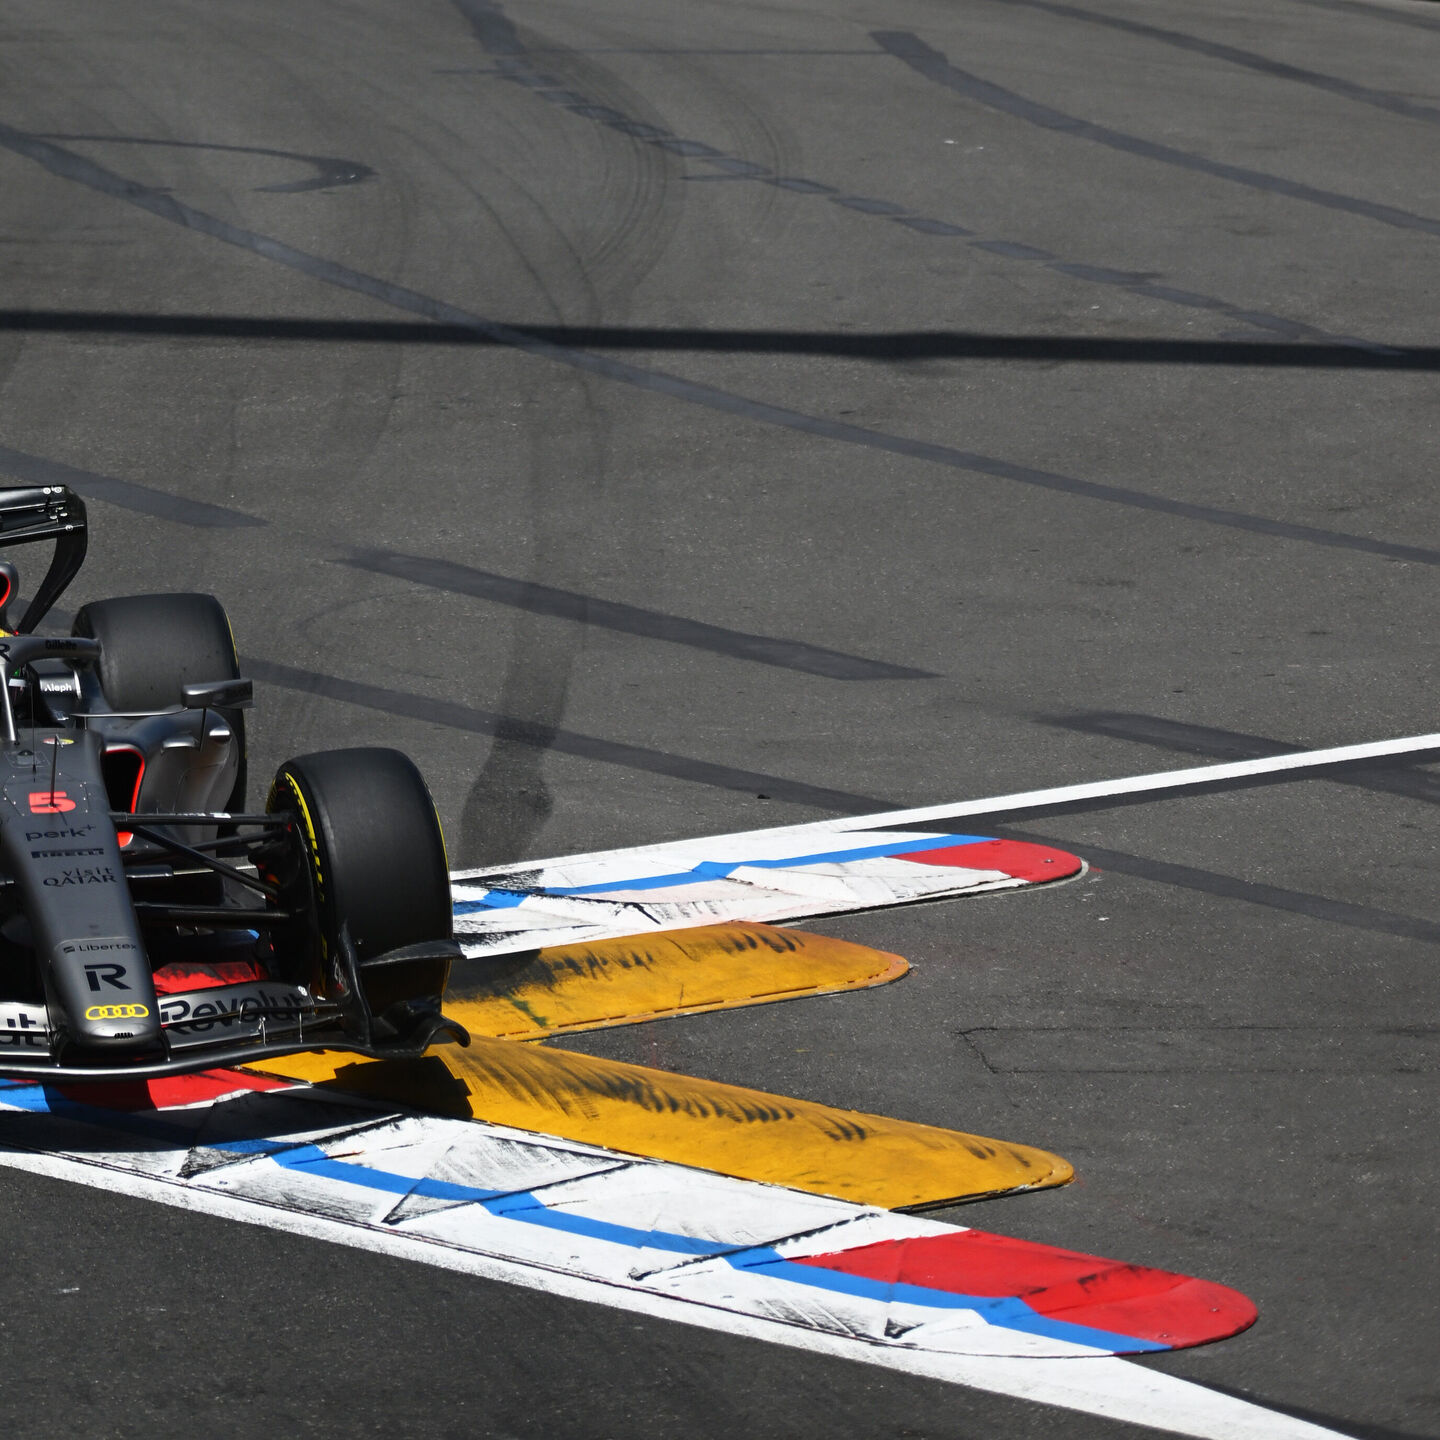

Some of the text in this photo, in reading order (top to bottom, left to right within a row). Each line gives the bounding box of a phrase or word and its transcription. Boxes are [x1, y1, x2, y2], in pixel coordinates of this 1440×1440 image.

[45, 639, 78, 651] Gillette
[44, 682, 73, 694] Aleph
[28, 790, 77, 814] 5
[31, 847, 105, 859] PIRELLI
[62, 866, 113, 877] visit
[43, 874, 118, 888] QATAR
[78, 943, 137, 953] Libertex
[161, 988, 305, 1036] Revolut
